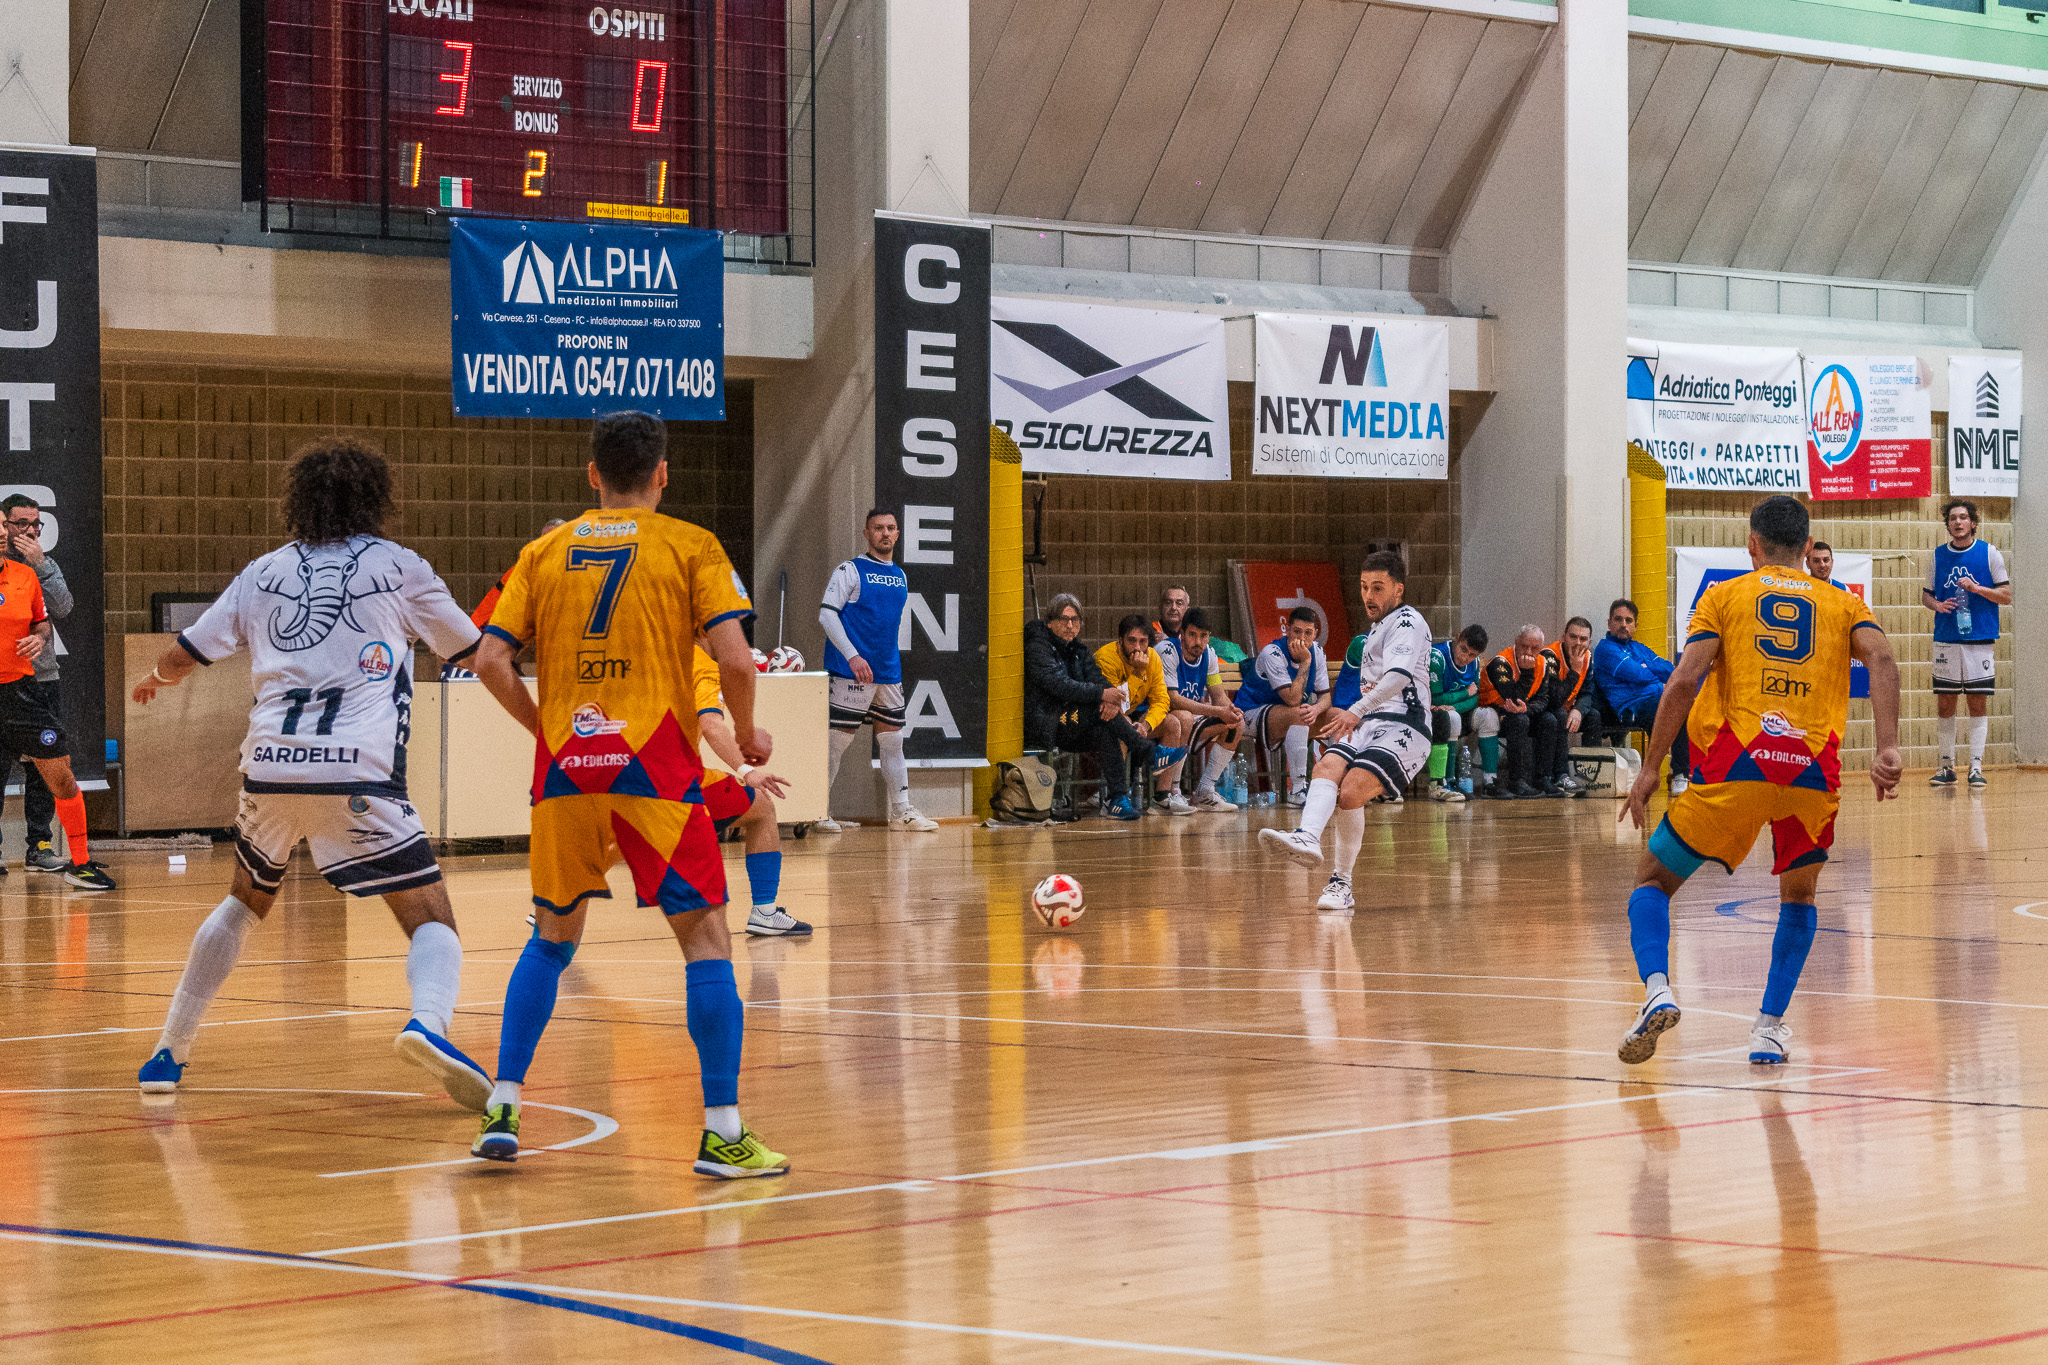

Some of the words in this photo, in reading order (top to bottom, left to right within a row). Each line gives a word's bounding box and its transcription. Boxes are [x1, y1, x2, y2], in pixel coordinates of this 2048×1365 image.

[589, 7, 665, 41] OSPITI
[436, 40, 474, 117] 3
[513, 74, 562, 99] SERVIZIO
[631, 60, 668, 133] 0
[514, 110, 559, 135] BONUS
[412, 142, 423, 188] 1
[523, 150, 548, 197] 2
[657, 161, 668, 205] 1
[558, 243, 678, 289] ALPHA
[558, 296, 616, 306] mediazioni
[620, 297, 679, 309] immobiliari
[482, 312, 494, 322] Via
[494, 313, 525, 324] Cervese,
[526, 314, 538, 323] 251
[544, 315, 571, 325] Cesena
[576, 316, 586, 325] FC
[590, 316, 649, 328] info@alphacase.it
[653, 318, 666, 327] REA
[667, 319, 677, 328] FO
[678, 319, 701, 329] 337500
[558, 335, 613, 350] PROPONE
[616, 337, 628, 350] IN
[463, 353, 568, 395] VENDITA
[575, 356, 716, 398] 0547.071408
[1869, 365, 1895, 373] NOLEGGIO
[1895, 365, 1913, 373] BREVE
[1659, 374, 1730, 400] Adriatica
[1735, 379, 1797, 408] Ponteggi
[1260, 395, 1445, 440] NEXTMEDIA
[1658, 409, 1711, 422] PROGETTAZIONE
[1811, 411, 1832, 432] ALL
[1834, 410, 1861, 431] RENT
[1823, 434, 1847, 443] NOLEGGI
[1953, 427, 2019, 471] NMC
[1260, 443, 1316, 462] Sistemi
[1320, 446, 1331, 465] di
[1335, 447, 1445, 467] Comunicazione
[1716, 443, 1799, 463] PARAPETTI
[1696, 467, 1801, 488] MONTACARICHI
[566, 543, 638, 640] 7
[1755, 591, 1816, 665] 9
[281, 688, 346, 736] 11
[252, 746, 360, 764] GARDELLI
[582, 753, 630, 768] EDILCASS
[1771, 750, 1812, 767] EDILCASS
